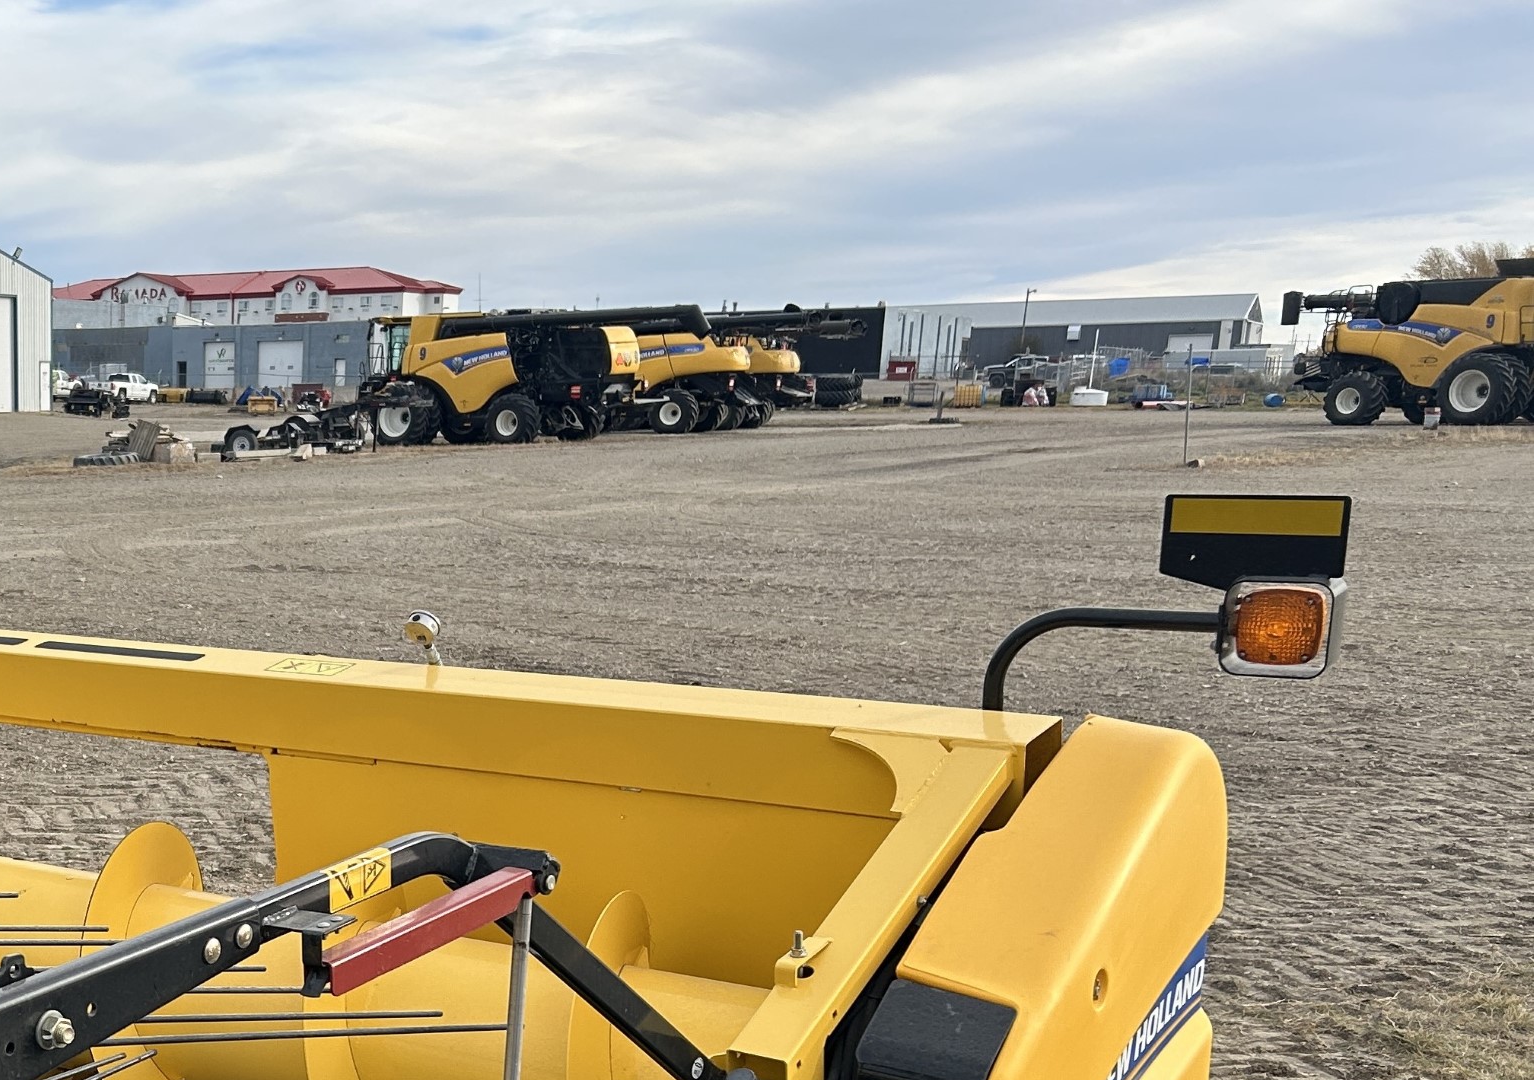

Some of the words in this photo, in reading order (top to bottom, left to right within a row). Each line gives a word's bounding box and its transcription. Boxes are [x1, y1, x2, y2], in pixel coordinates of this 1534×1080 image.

[111, 286, 167, 301] RADA
[1486, 314, 1495, 328] 9
[1411, 328, 1437, 338] HOLLAND
[419, 347, 427, 360] 9
[463, 356, 479, 366] NEW
[478, 350, 508, 361] HOLLAND
[640, 349, 665, 359] OLLAND
[1133, 958, 1205, 1062] HOLLAND
